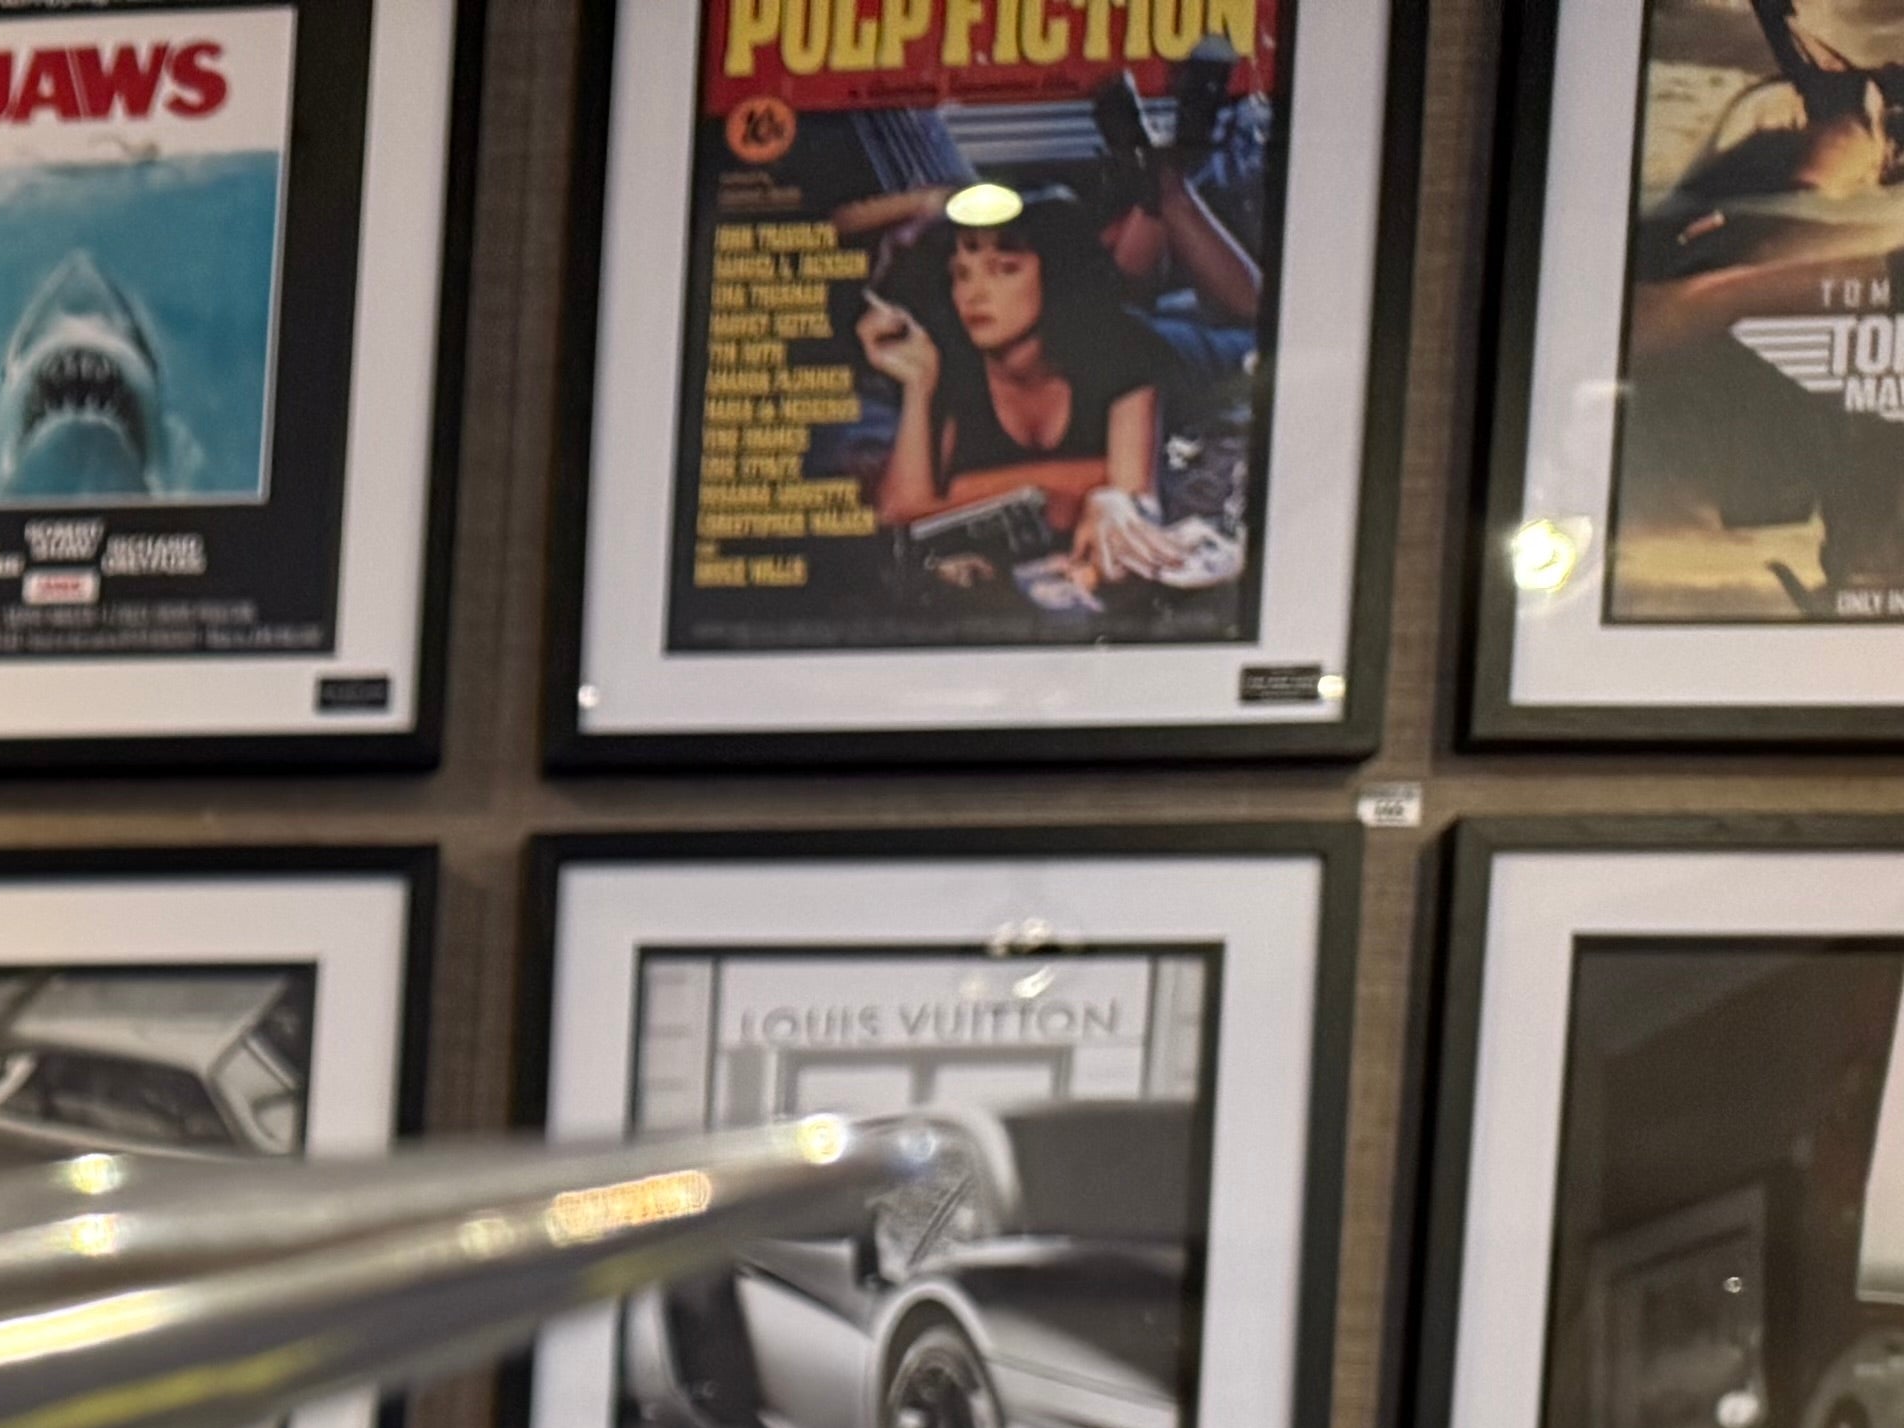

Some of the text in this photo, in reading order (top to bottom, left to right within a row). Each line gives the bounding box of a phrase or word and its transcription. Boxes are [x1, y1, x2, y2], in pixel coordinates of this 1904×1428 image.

[724, 0, 1257, 77] PULP FICTION
[1822, 278, 1892, 308] TOM
[1831, 314, 1904, 376] TO
[740, 998, 1121, 1046] LOUIS VUITTON
